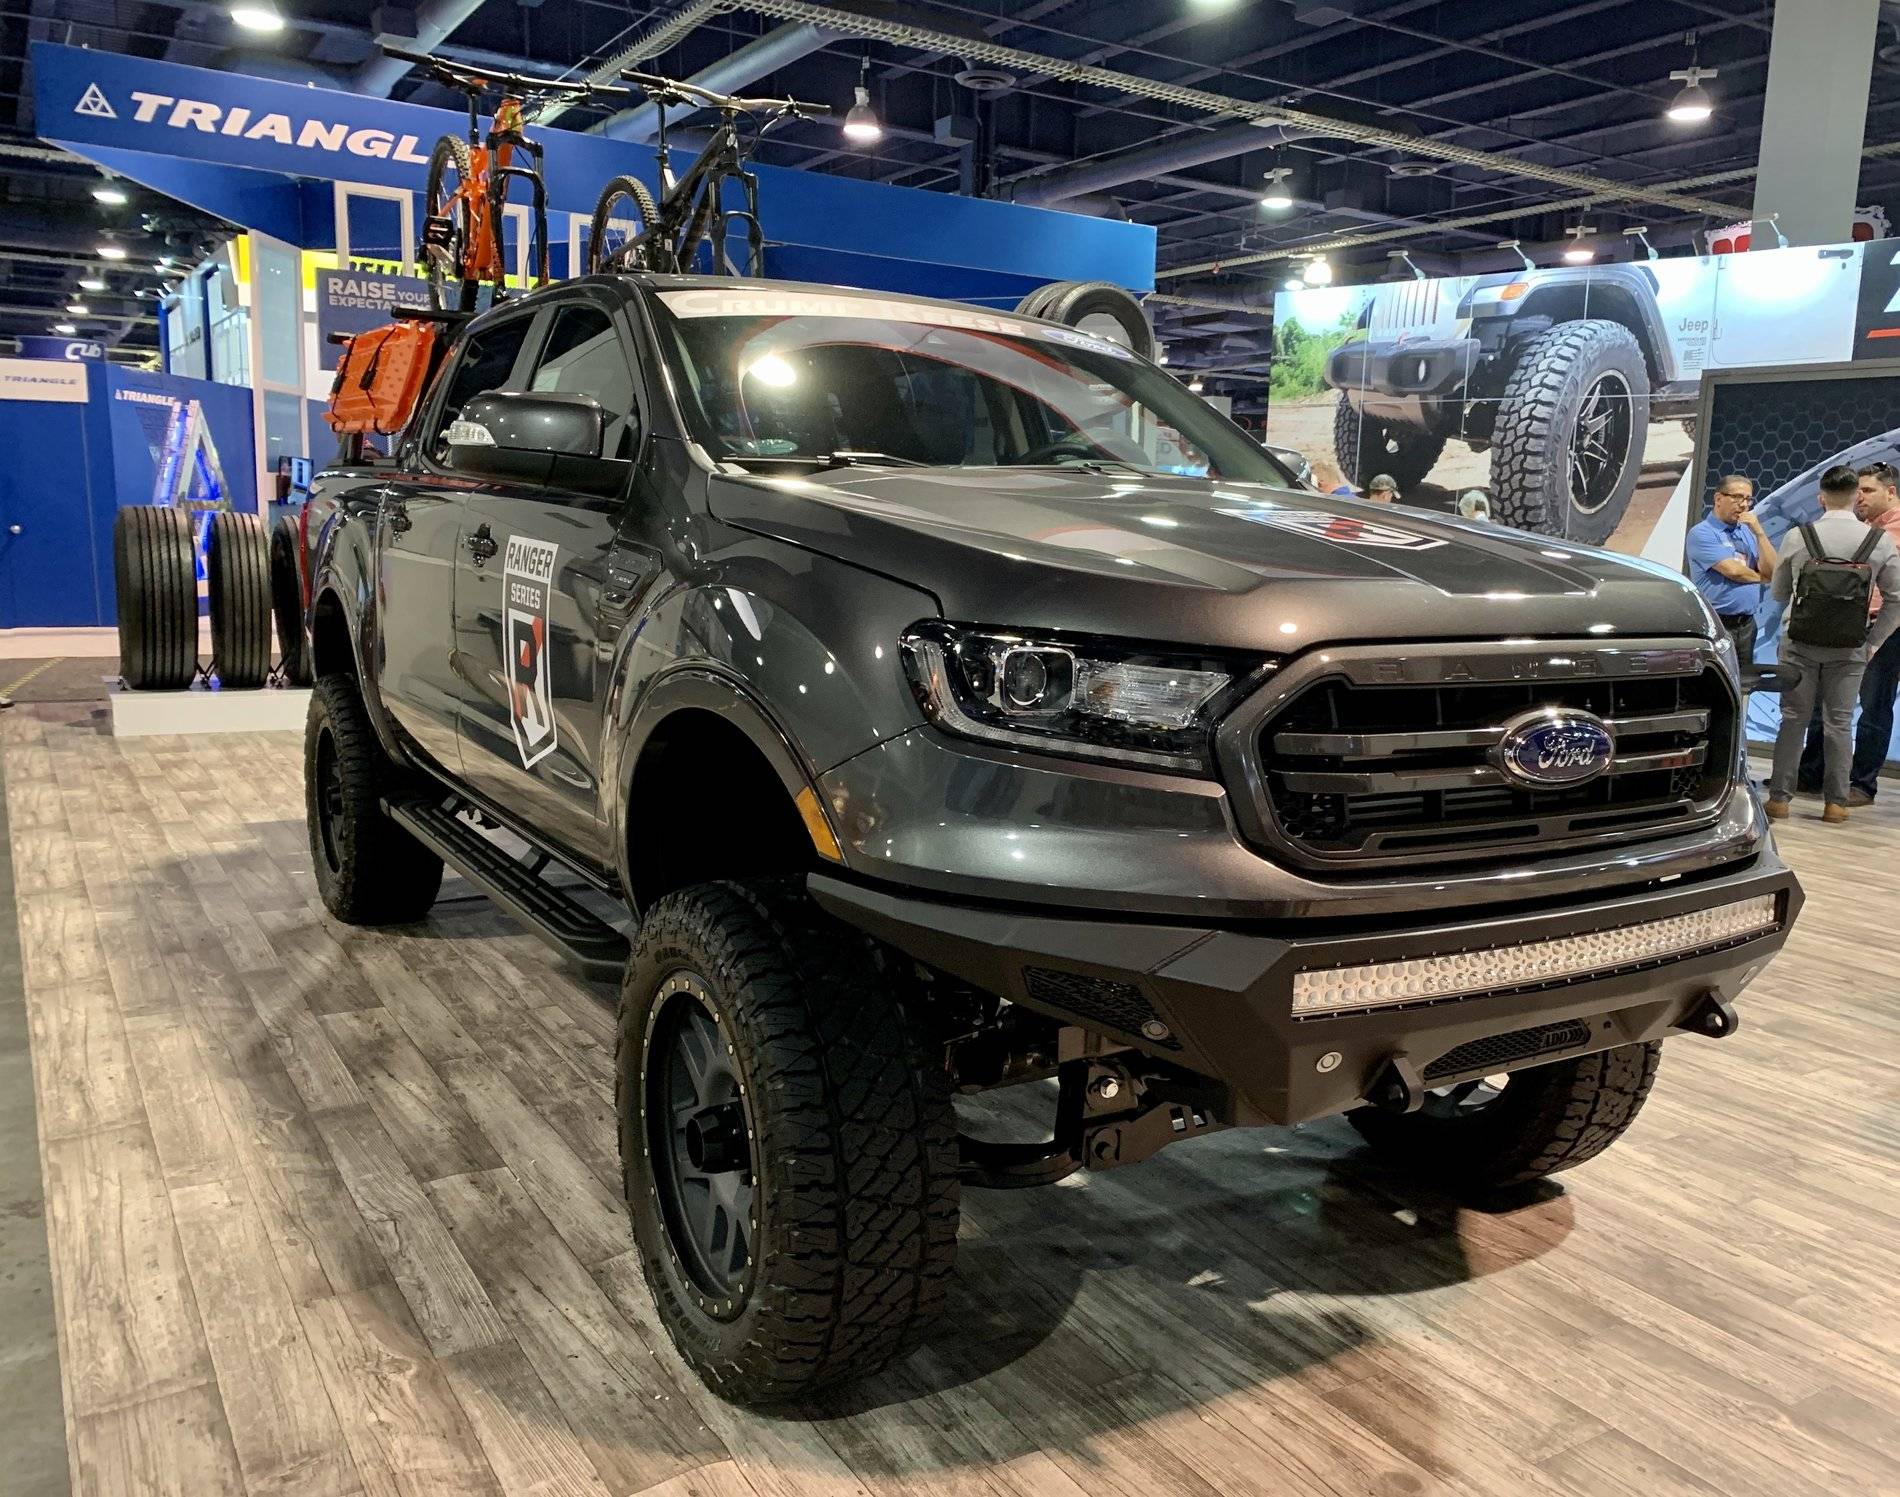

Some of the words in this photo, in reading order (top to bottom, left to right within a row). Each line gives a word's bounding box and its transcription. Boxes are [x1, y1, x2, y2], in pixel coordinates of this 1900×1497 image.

[130, 91, 455, 169] TRIANGL
[327, 277, 396, 301] RAISE
[1679, 317, 1709, 333] Jeep
[4, 375, 78, 386] TRIANGLE
[122, 389, 176, 407] TRIANGLE
[506, 542, 553, 578] RANGER
[511, 583, 540, 609] SERIES
[1537, 731, 1596, 769] Ford
